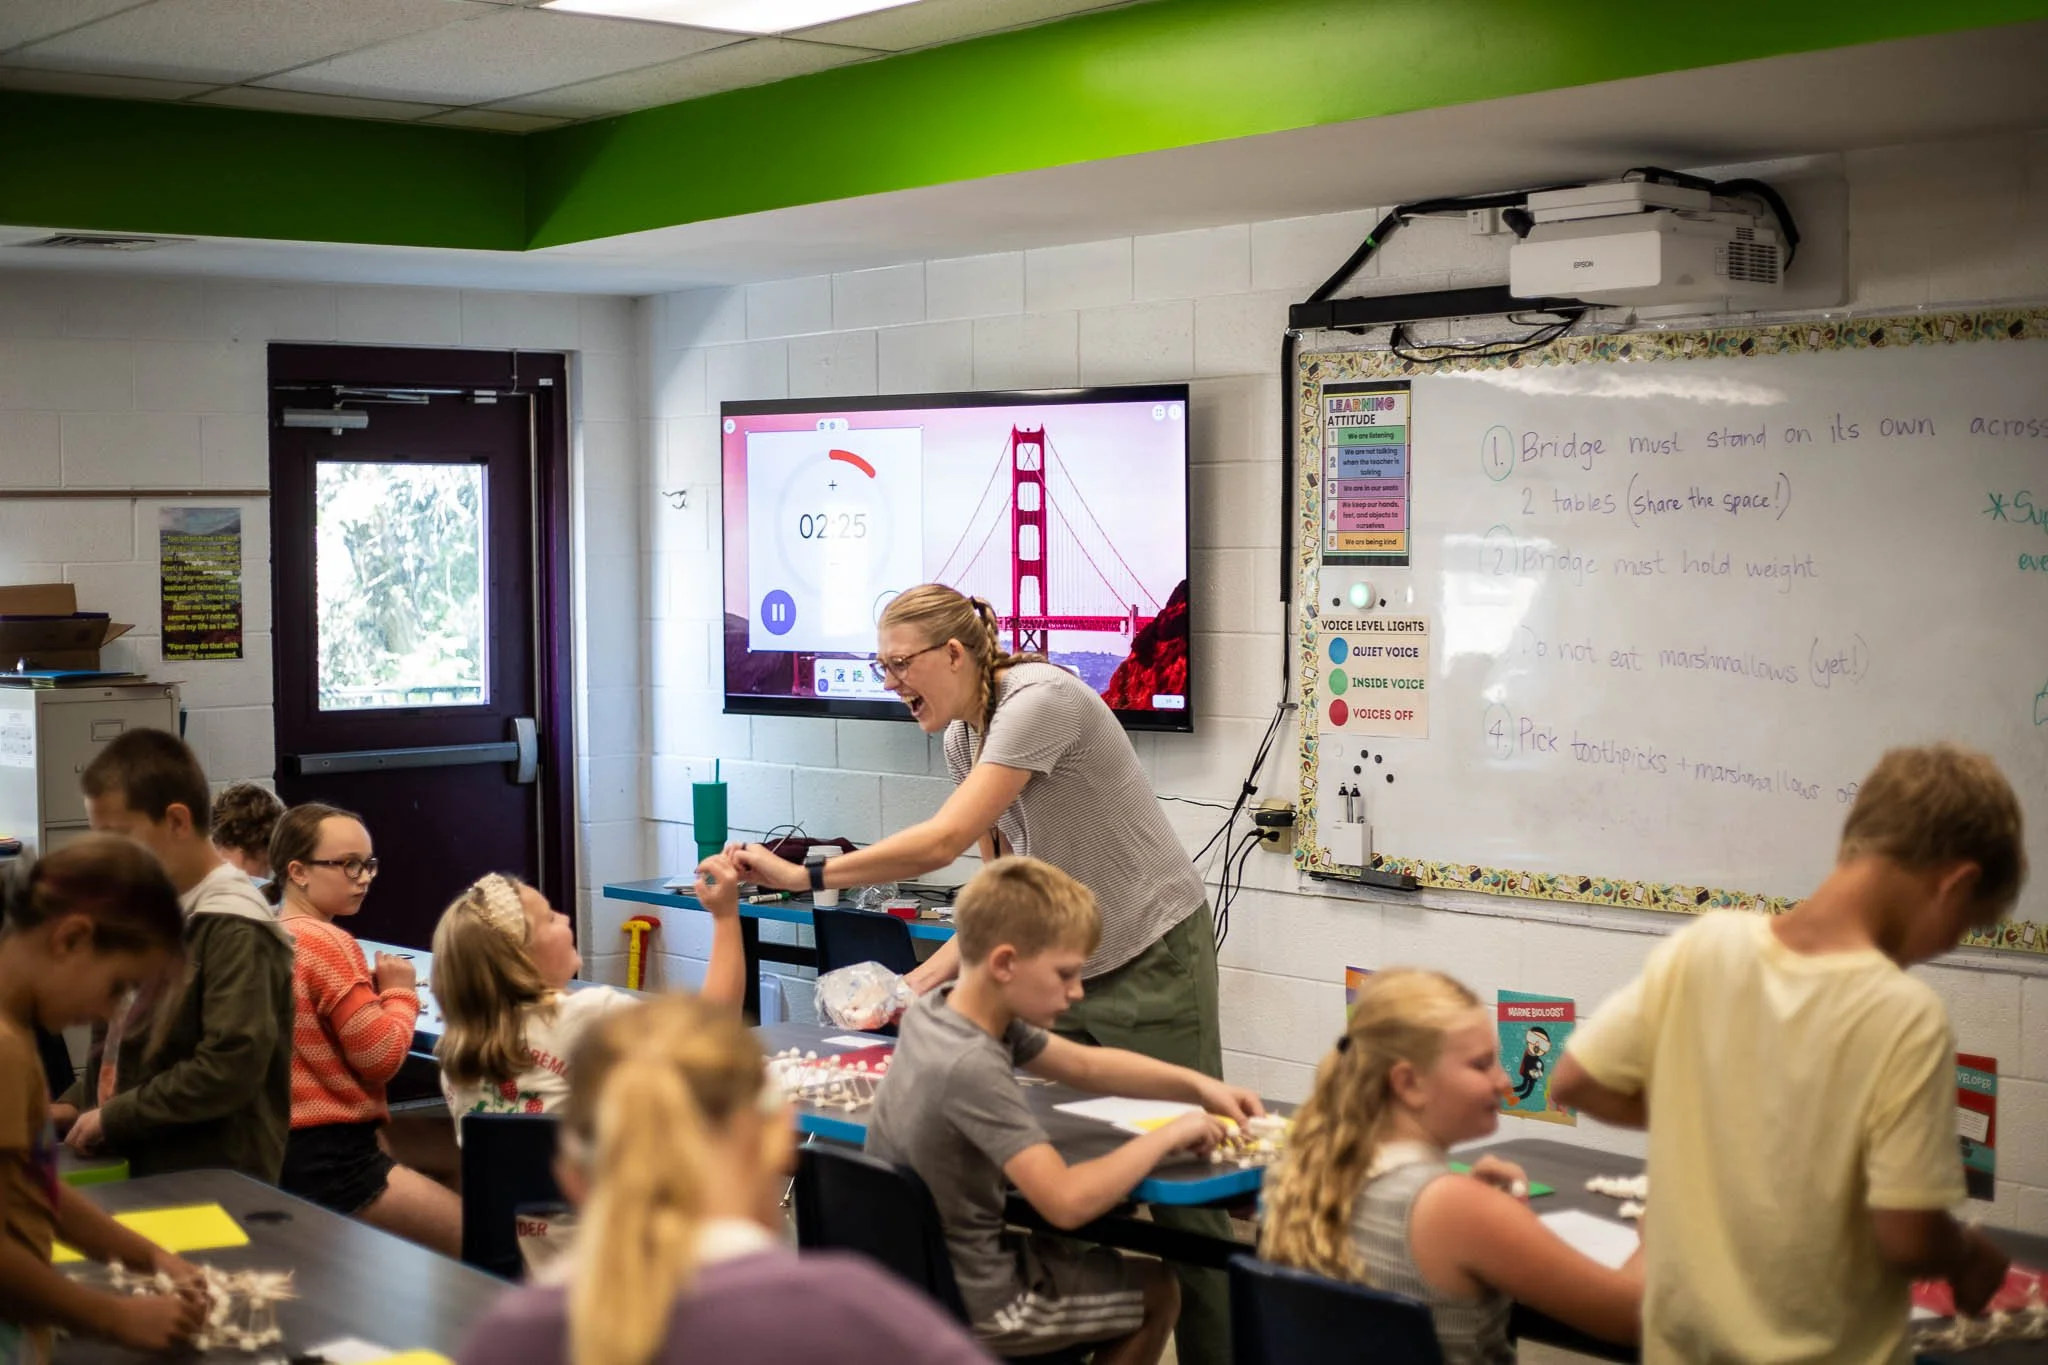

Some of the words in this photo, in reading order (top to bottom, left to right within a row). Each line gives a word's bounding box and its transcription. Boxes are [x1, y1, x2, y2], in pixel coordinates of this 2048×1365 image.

[1573, 260, 1594, 268] EPSON
[1329, 396, 1394, 413] LEARNING
[1328, 414, 1376, 426] ATTITUDE
[1369, 432, 1394, 440] listening
[1522, 431, 1606, 471] Bridge
[1629, 431, 1684, 455] must
[1706, 424, 1766, 449] stand
[1784, 427, 1813, 444] on
[1830, 412, 1860, 444] its
[1880, 416, 1936, 437] own
[1969, 416, 2048, 439] across
[1330, 456, 1336, 468] 2
[1330, 482, 1336, 494] 3
[1522, 487, 1535, 515] 2
[1552, 488, 1616, 514] tables
[1627, 472, 1683, 528] (share
[1688, 486, 1714, 508] the
[1724, 472, 1792, 521] space!)
[1329, 509, 1336, 520] 4
[800, 513, 866, 539] 02:25
[1522, 545, 1599, 586] Bridge
[1614, 553, 1664, 576] must
[1682, 549, 1731, 575] hold
[1746, 554, 1818, 594] weight
[1322, 620, 1353, 631] VOICE
[1356, 621, 1384, 631] LEVEL
[1387, 621, 1424, 632] LIGHTS
[1352, 646, 1383, 657] QUIET
[1385, 647, 1419, 658] VOICE
[1558, 640, 1597, 664] not
[1609, 648, 1642, 672] eat
[1659, 646, 1799, 684] marshmallows
[1808, 632, 1870, 688] (yet!)
[1352, 677, 1388, 688] INSIDE
[1391, 679, 1425, 689] VOICE
[1352, 708, 1391, 720] VOICES
[1394, 710, 1414, 720] OFF
[1519, 716, 1559, 753] Pick
[1570, 731, 1667, 775] toothpicks
[1695, 760, 1820, 802] marshmallows
[1508, 1007, 1531, 1017] MARINE
